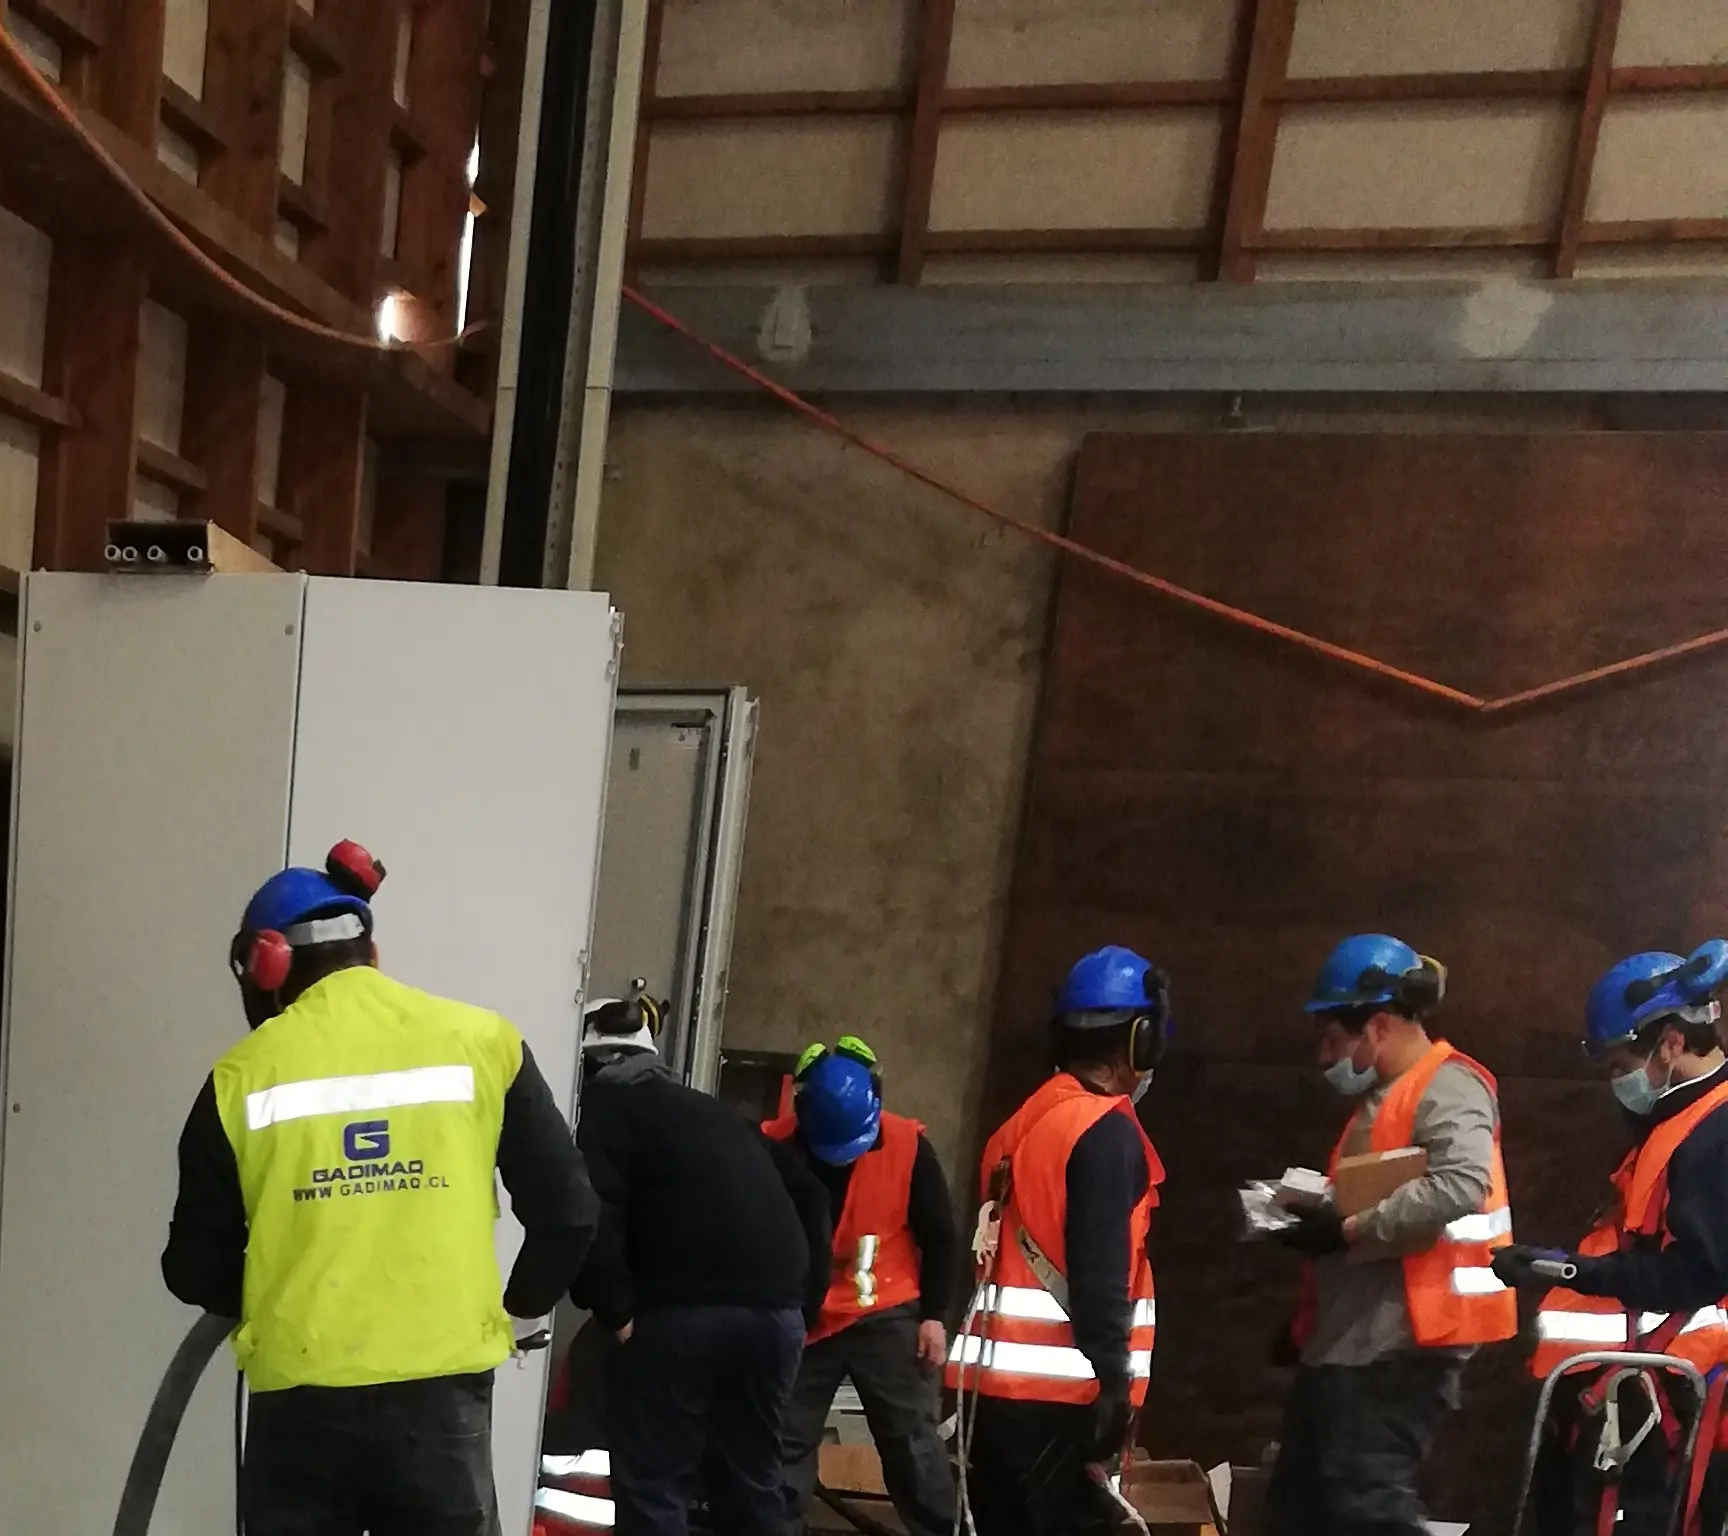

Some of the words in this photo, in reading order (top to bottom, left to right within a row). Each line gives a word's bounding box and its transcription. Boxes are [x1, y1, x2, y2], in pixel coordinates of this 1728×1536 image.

[343, 1119, 390, 1161] G
[312, 1160, 424, 1183] GADIMAQ
[293, 1175, 450, 1201] WWWGADIMAQ.CL
